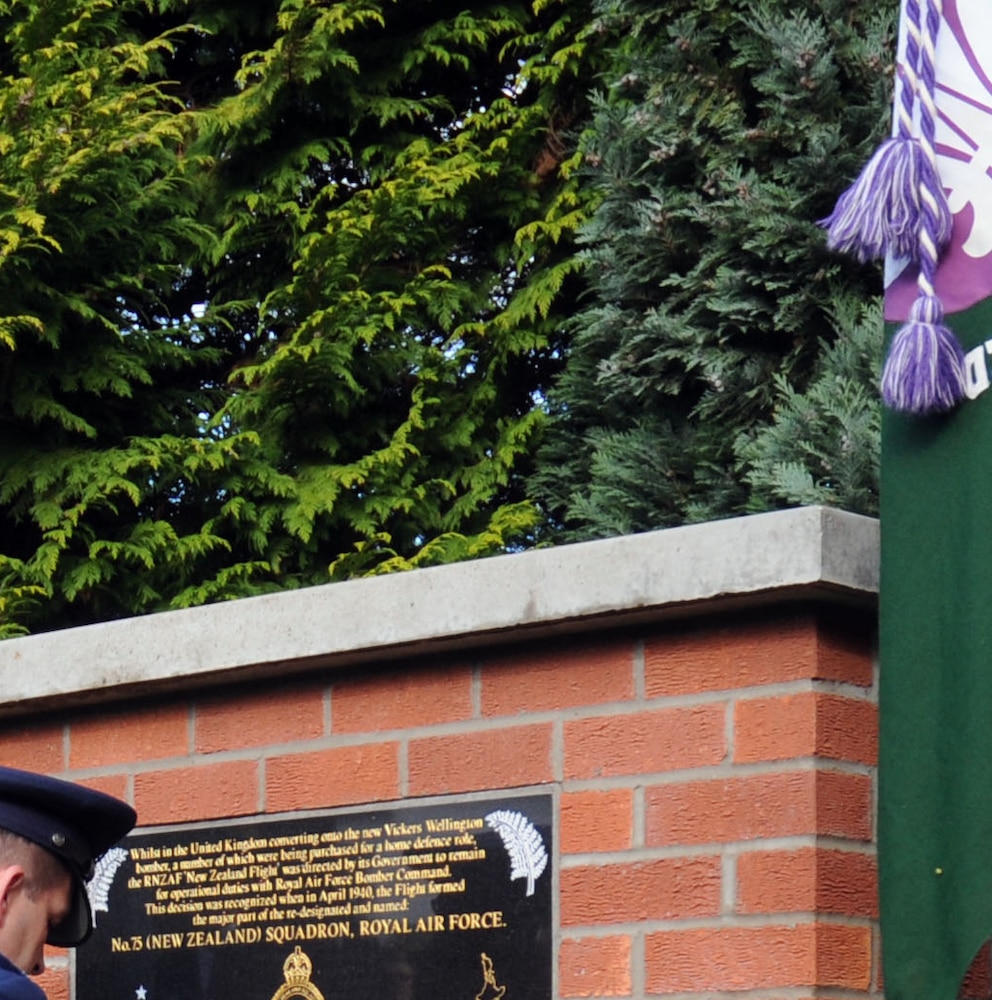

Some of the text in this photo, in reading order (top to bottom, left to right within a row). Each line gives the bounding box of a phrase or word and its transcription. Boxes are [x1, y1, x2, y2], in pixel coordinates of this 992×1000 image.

[130, 818, 483, 860] Whilst in the United Kingdom converting onto the new Vickers Wellington
[135, 832, 477, 874] bomber, a number of which were being purchased for a home defence role,
[128, 877, 142, 888] the
[144, 872, 182, 887] RNZAF
[209, 867, 247, 881] Zealand
[282, 865, 300, 875] was
[302, 859, 342, 873] directed
[344, 858, 356, 872] by
[358, 856, 370, 869] its
[371, 852, 433, 867] Government
[435, 852, 447, 863] to
[448, 847, 486, 861] remain
[156, 864, 452, 901] for operational duties with Royal Air Force Bomber Command.
[145, 879, 466, 915] This decision was recognized when in April 1940, the Flight formed
[192, 913, 207, 925] the
[209, 911, 235, 926] major
[236, 912, 257, 926] part
[258, 909, 269, 921] of
[269, 908, 284, 920] the
[286, 902, 352, 919] re-designated
[353, 901, 371, 914] and
[146, 932, 183, 950] (NEW
[186, 926, 262, 947] ZEALAND)
[266, 921, 354, 941] SQUADRON,
[360, 918, 412, 936] ROYAL
[416, 914, 445, 931] AIR
[449, 911, 507, 931] FORCE.
